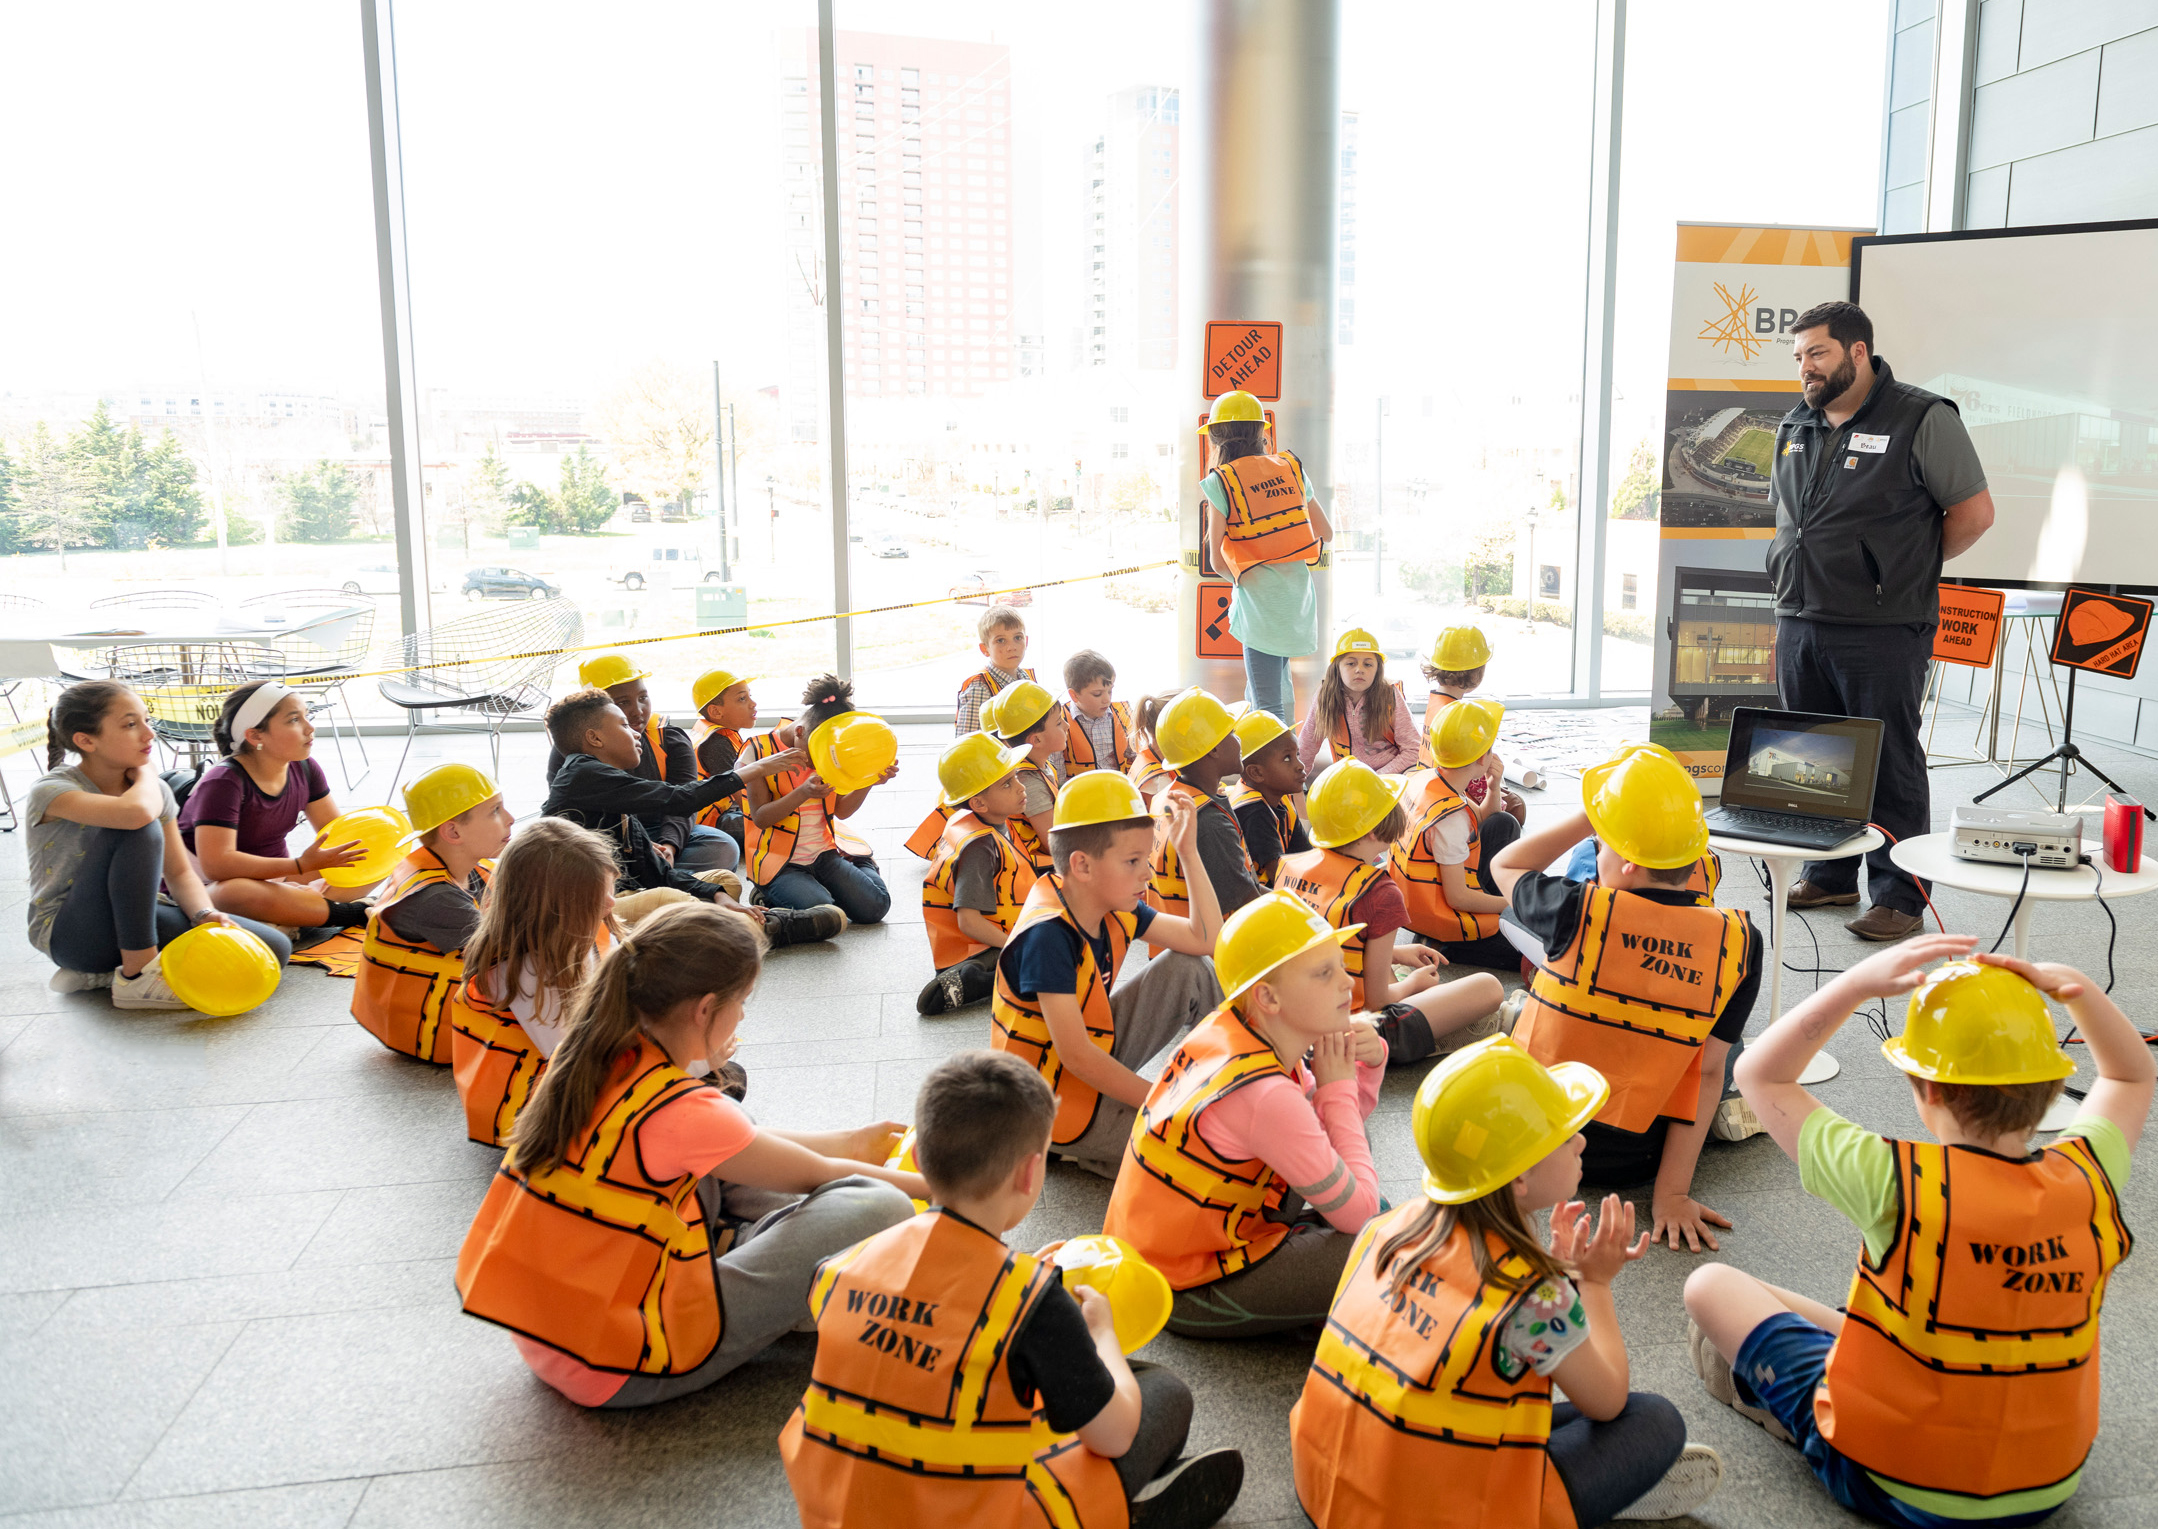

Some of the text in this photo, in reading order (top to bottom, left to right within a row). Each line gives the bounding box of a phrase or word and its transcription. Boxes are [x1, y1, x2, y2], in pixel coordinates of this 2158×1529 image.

[1755, 307, 1798, 334] BP
[1211, 329, 1263, 379] DETOUR
[1229, 346, 1272, 390] AHEAD
[1250, 475, 1285, 494] WORK
[1265, 486, 1296, 499] ZONE
[1940, 605, 1997, 621] NSTRUCTION
[1942, 618, 1979, 636] WORK
[1943, 634, 1972, 647] AHEAD
[2092, 638, 2139, 668] HARD HAT AREA
[1284, 875, 1323, 896] WORK
[1621, 932, 1694, 959] WORK
[1640, 953, 1703, 986] ZONE
[1969, 1235, 2070, 1267] WORK
[2002, 1268, 2084, 1293] ZONE
[847, 1289, 939, 1328] WORK
[1379, 1281, 1438, 1342] ZONE
[858, 1319, 942, 1373] ZONE
